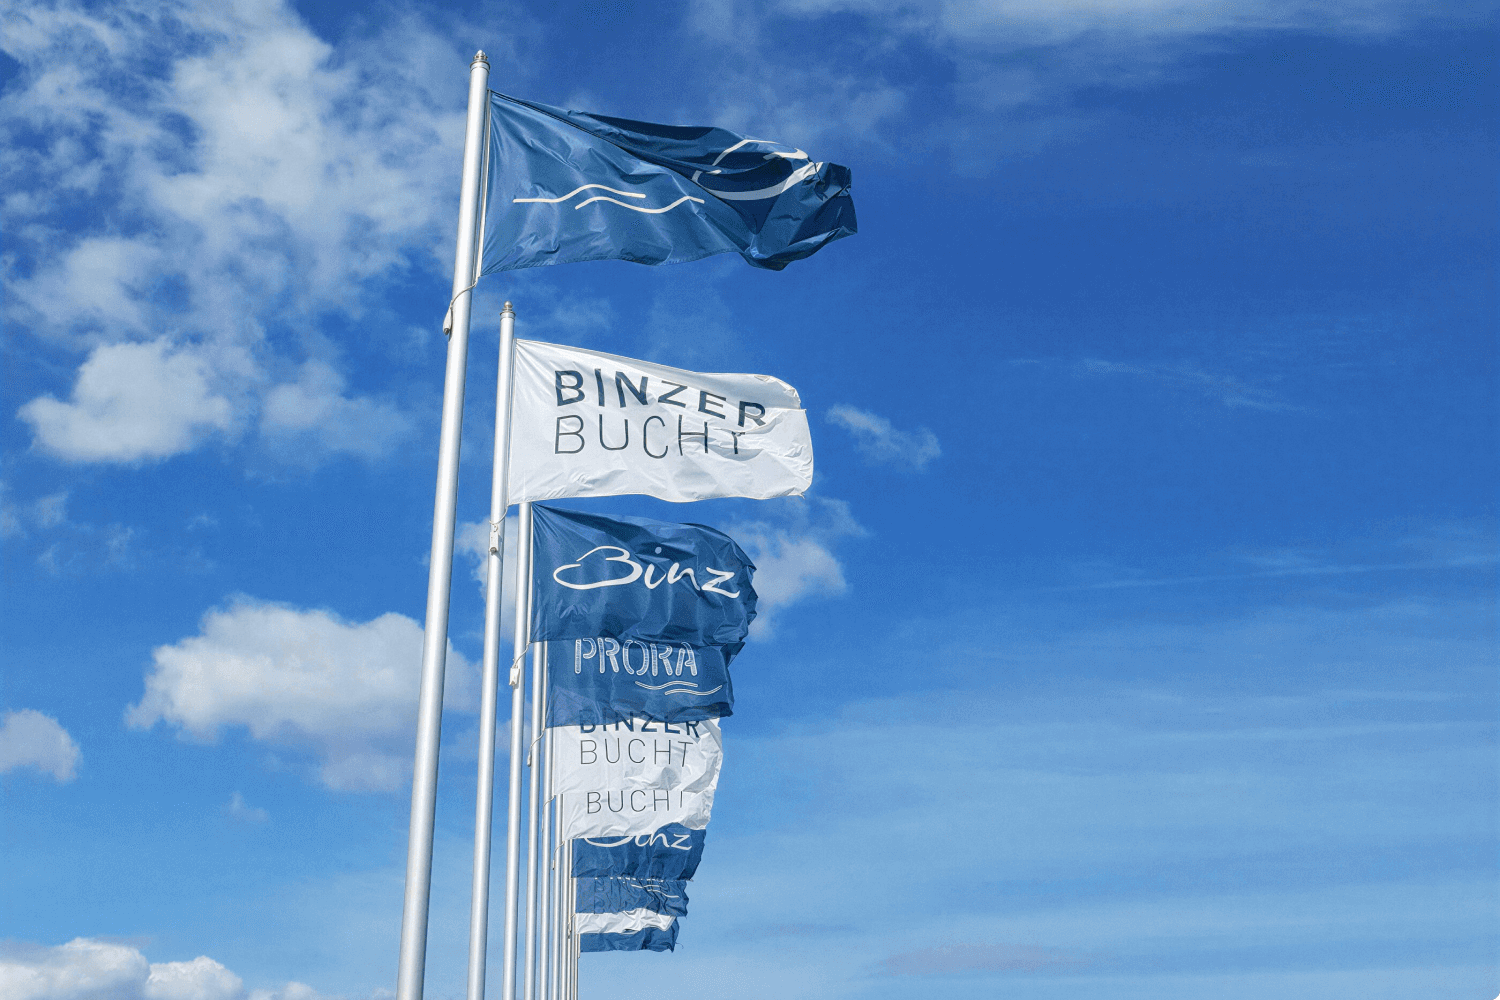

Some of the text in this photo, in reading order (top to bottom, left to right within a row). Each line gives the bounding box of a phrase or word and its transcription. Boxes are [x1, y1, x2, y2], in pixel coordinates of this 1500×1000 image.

[554, 368, 767, 428] BINZER
[554, 413, 746, 459] BUCHT
[553, 545, 741, 599] Binz
[574, 637, 698, 677] PRORA
[580, 738, 694, 768] BUCHT
